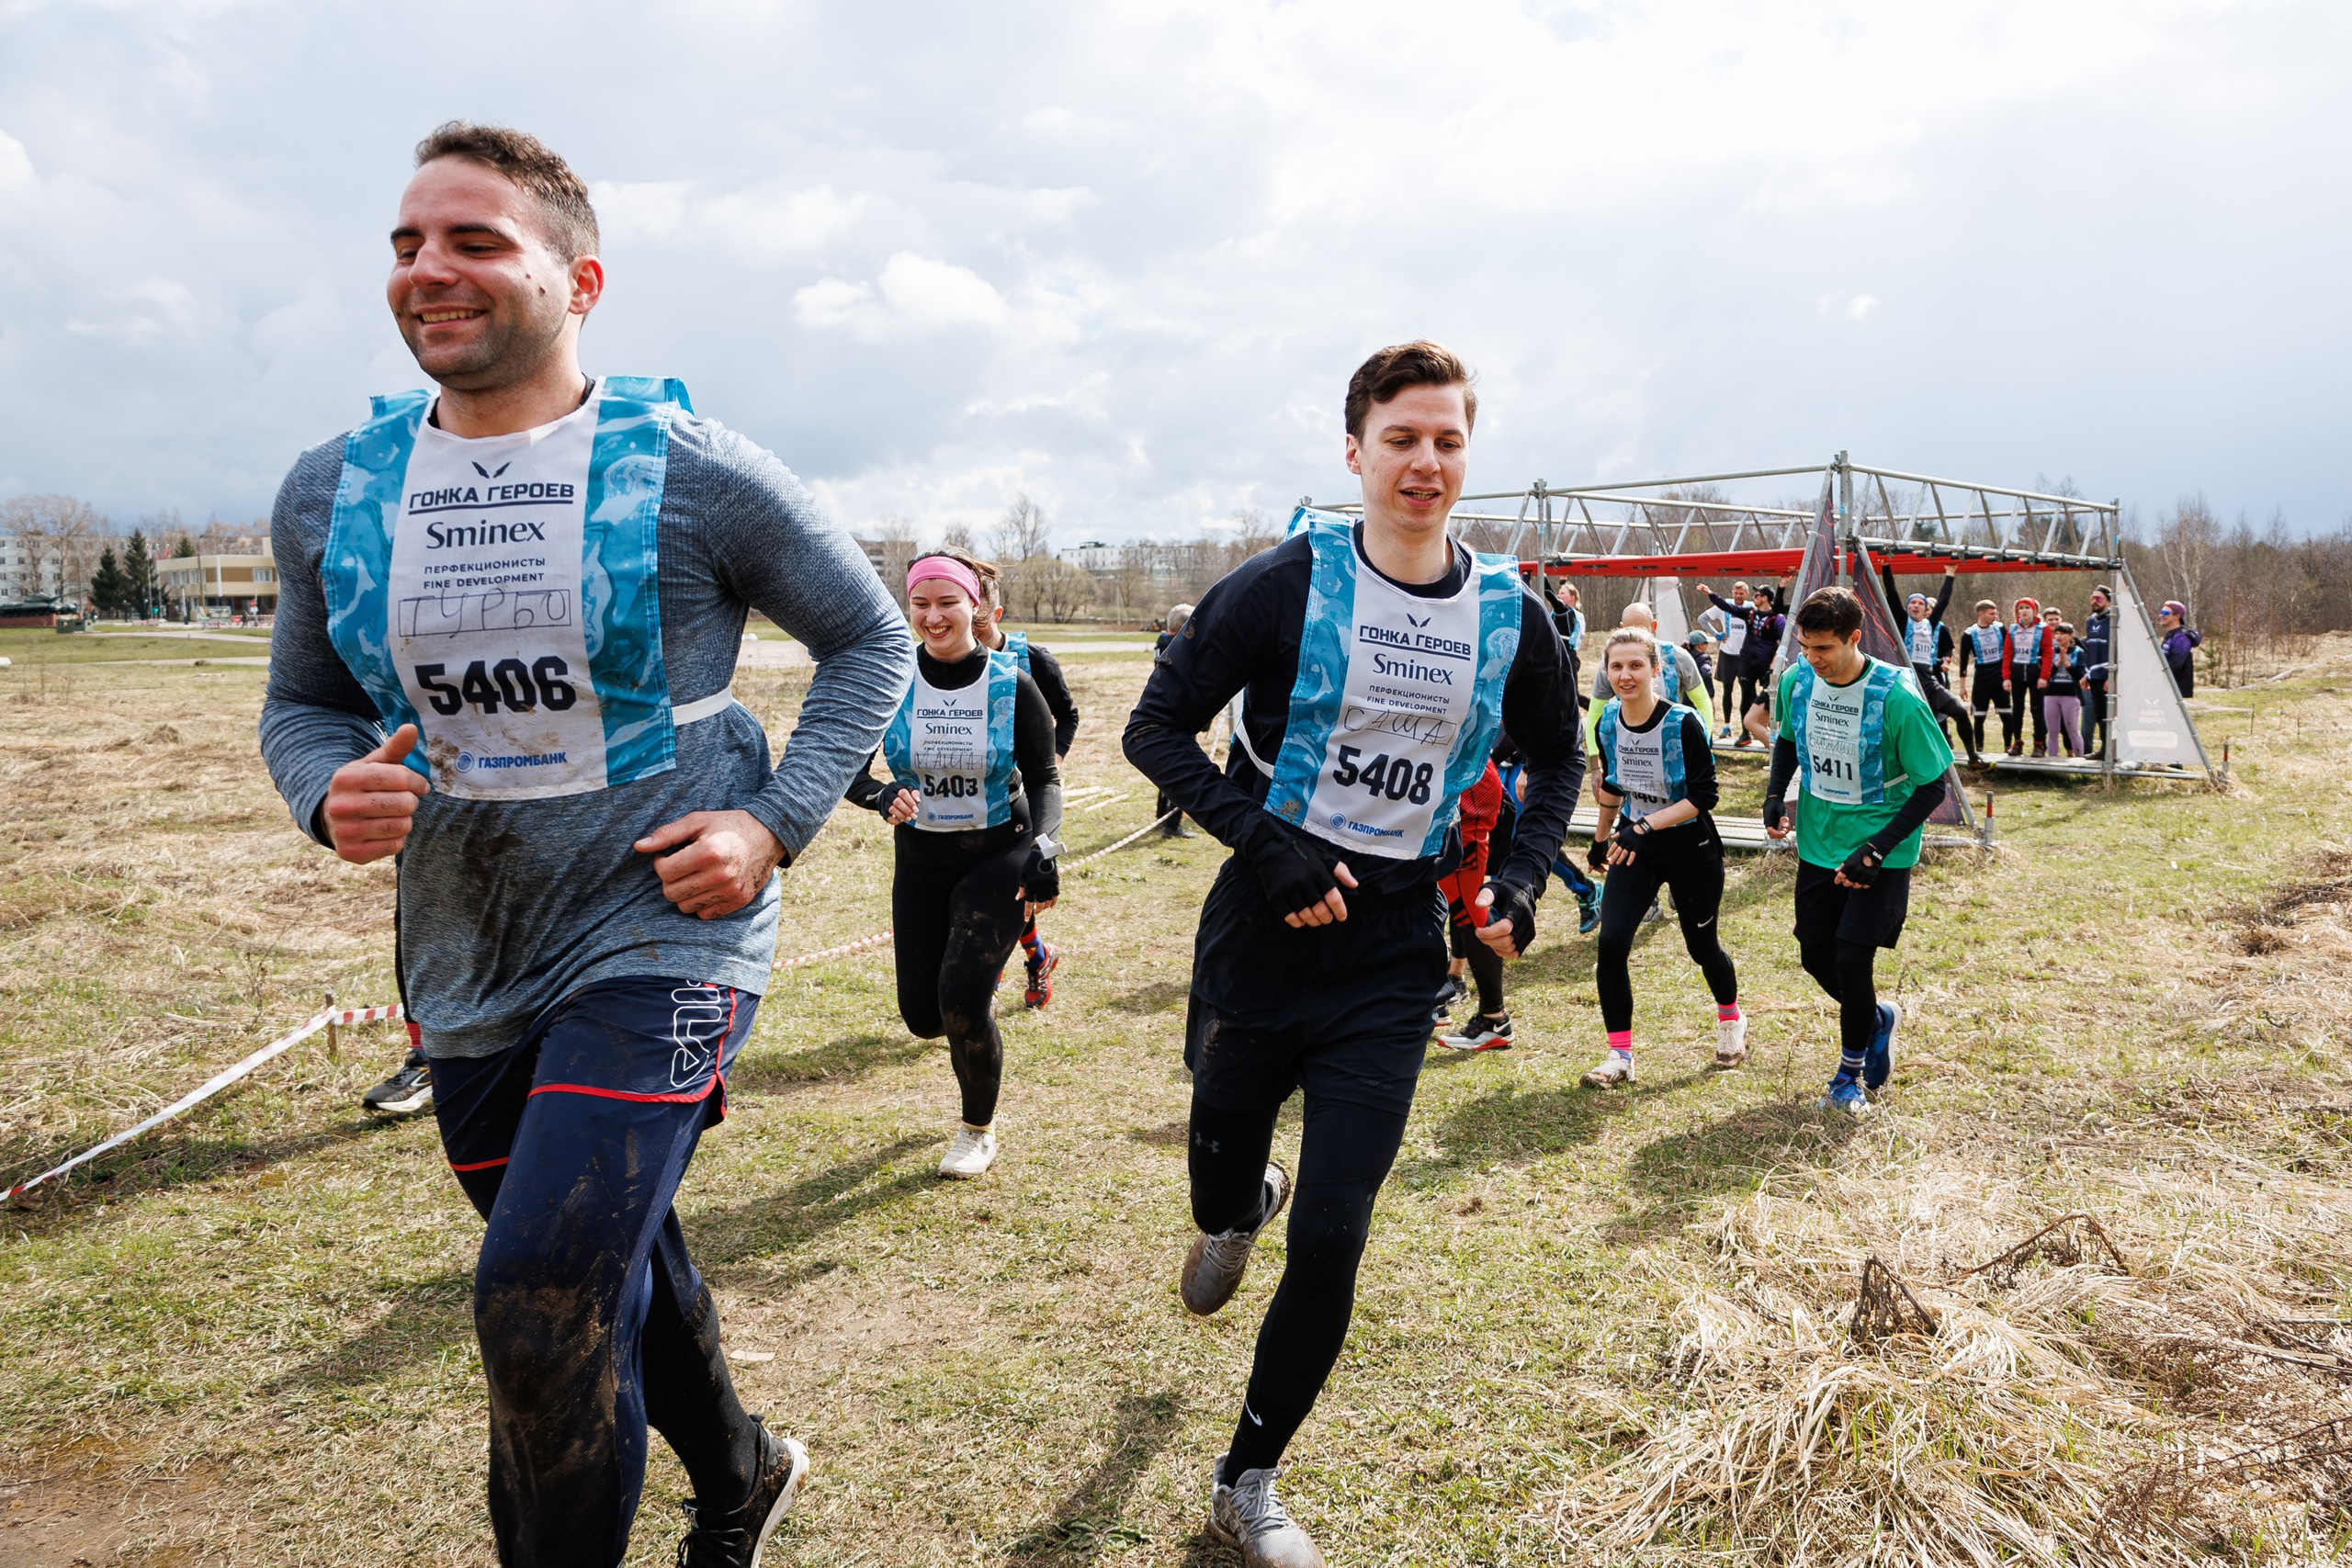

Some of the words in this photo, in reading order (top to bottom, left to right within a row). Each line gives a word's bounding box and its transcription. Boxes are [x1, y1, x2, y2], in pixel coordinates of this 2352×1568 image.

[410, 486, 480, 509] ГОНКА
[487, 482, 574, 502] ГЕРОЕВ
[425, 519, 546, 549] Sminex
[424, 558, 546, 574] ПЕРФЕКЦИОНИСТЫ
[423, 578, 451, 589] FINE
[457, 572, 545, 587] DEVELOPMENT
[1359, 625, 1410, 645] ГОНКА
[1415, 634, 1472, 655] ГЕРОЕВ
[1372, 653, 1453, 685] Sminex
[414, 655, 577, 716] 5406
[1369, 684, 1450, 705] ПЕРФЕКЦИОНИСТЫ
[917, 708, 945, 716] ГОНКА
[1366, 695, 1385, 705] FINE
[1388, 699, 1447, 715] DEVELOPMENT
[1811, 699, 1830, 708] ГОНКА
[1831, 704, 1859, 714] ГЕРОЕВ
[925, 722, 972, 735] Sminex
[1815, 712, 1849, 727] Sminex
[478, 751, 568, 770] ГАЗПРОМБАНК
[1622, 756, 1653, 767] Sminex
[1813, 754, 1852, 781] 5411
[1332, 744, 1434, 806] 5408
[923, 774, 978, 797] 5403
[1348, 821, 1404, 838] ГАЗПРОМБАНК
[671, 979, 722, 1088] ILA
